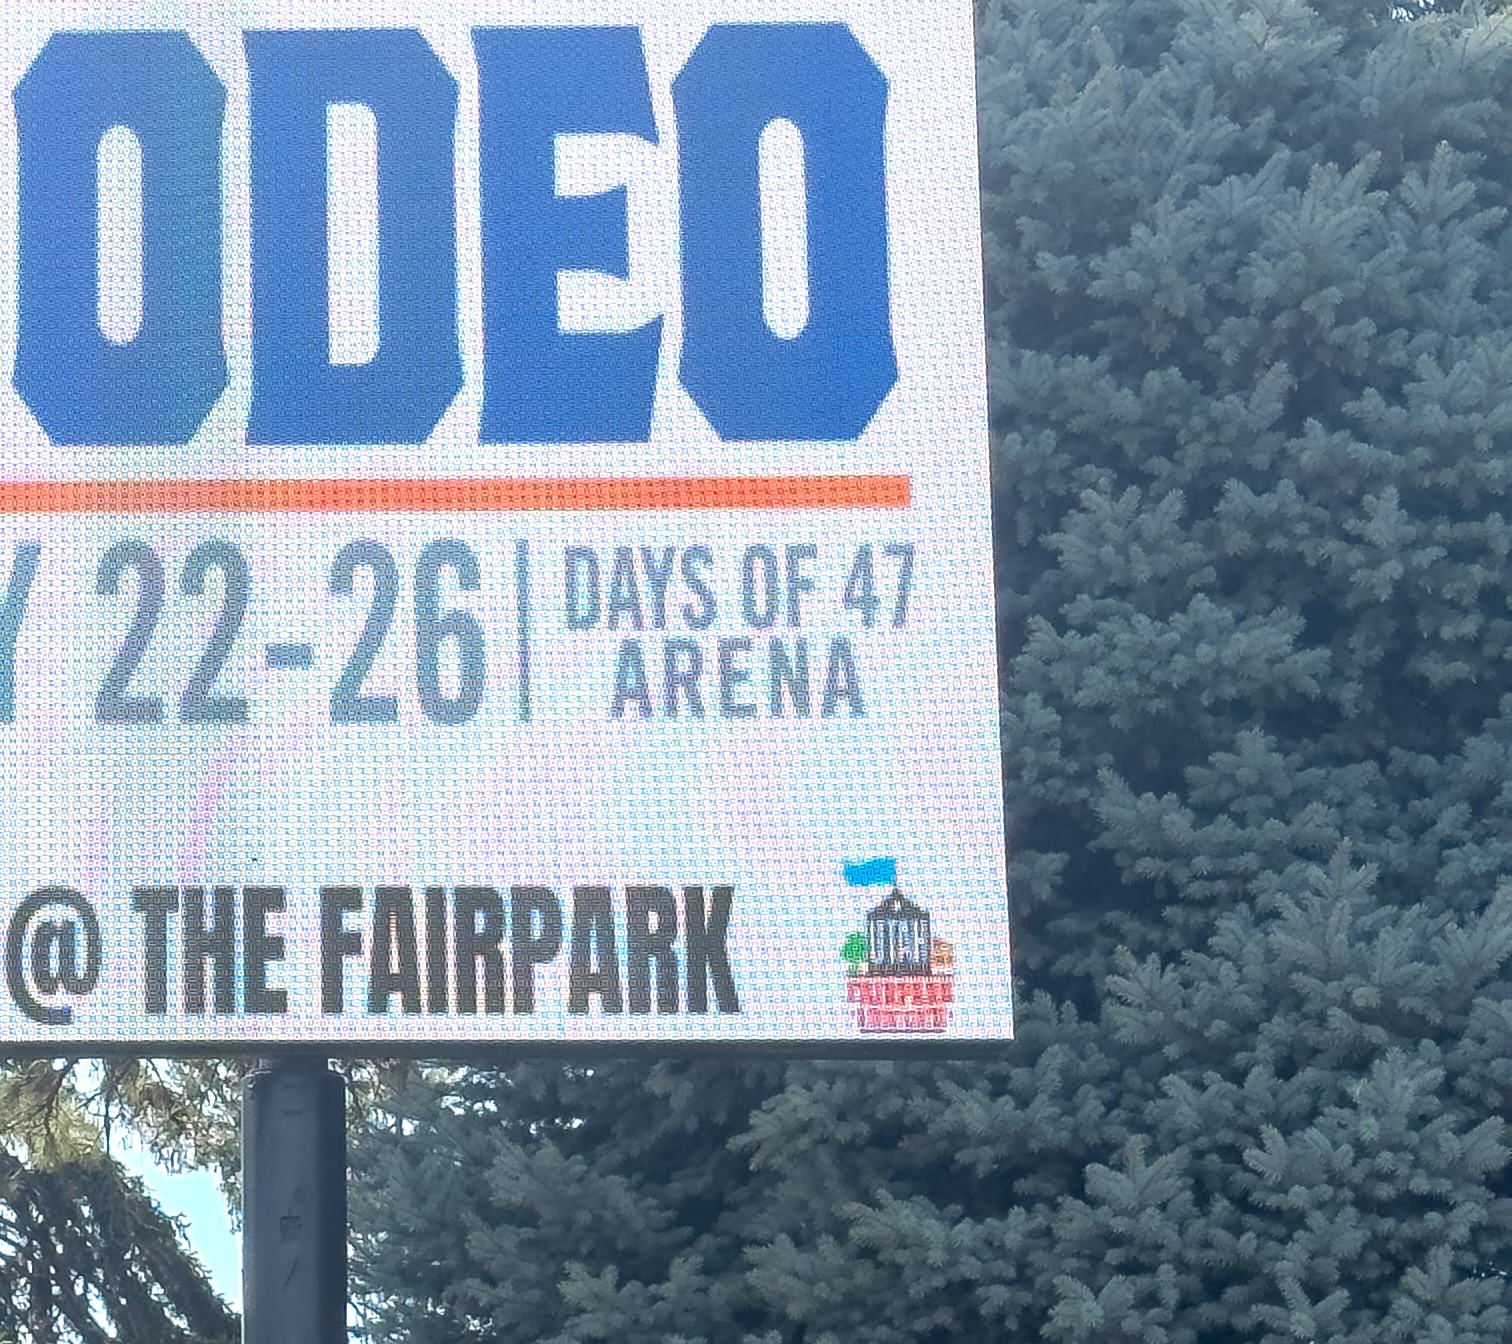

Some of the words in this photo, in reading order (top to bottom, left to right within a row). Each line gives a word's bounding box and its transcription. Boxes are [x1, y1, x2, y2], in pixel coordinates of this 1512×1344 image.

[94, 539, 488, 726] 22-26
[565, 545, 720, 631] DAYS
[741, 544, 818, 629] OF
[843, 543, 917, 630] 47
[610, 636, 868, 721] ARENA
[5, 886, 101, 1026] @
[131, 885, 287, 1017] THE
[319, 884, 739, 1017] FAIRPARK
